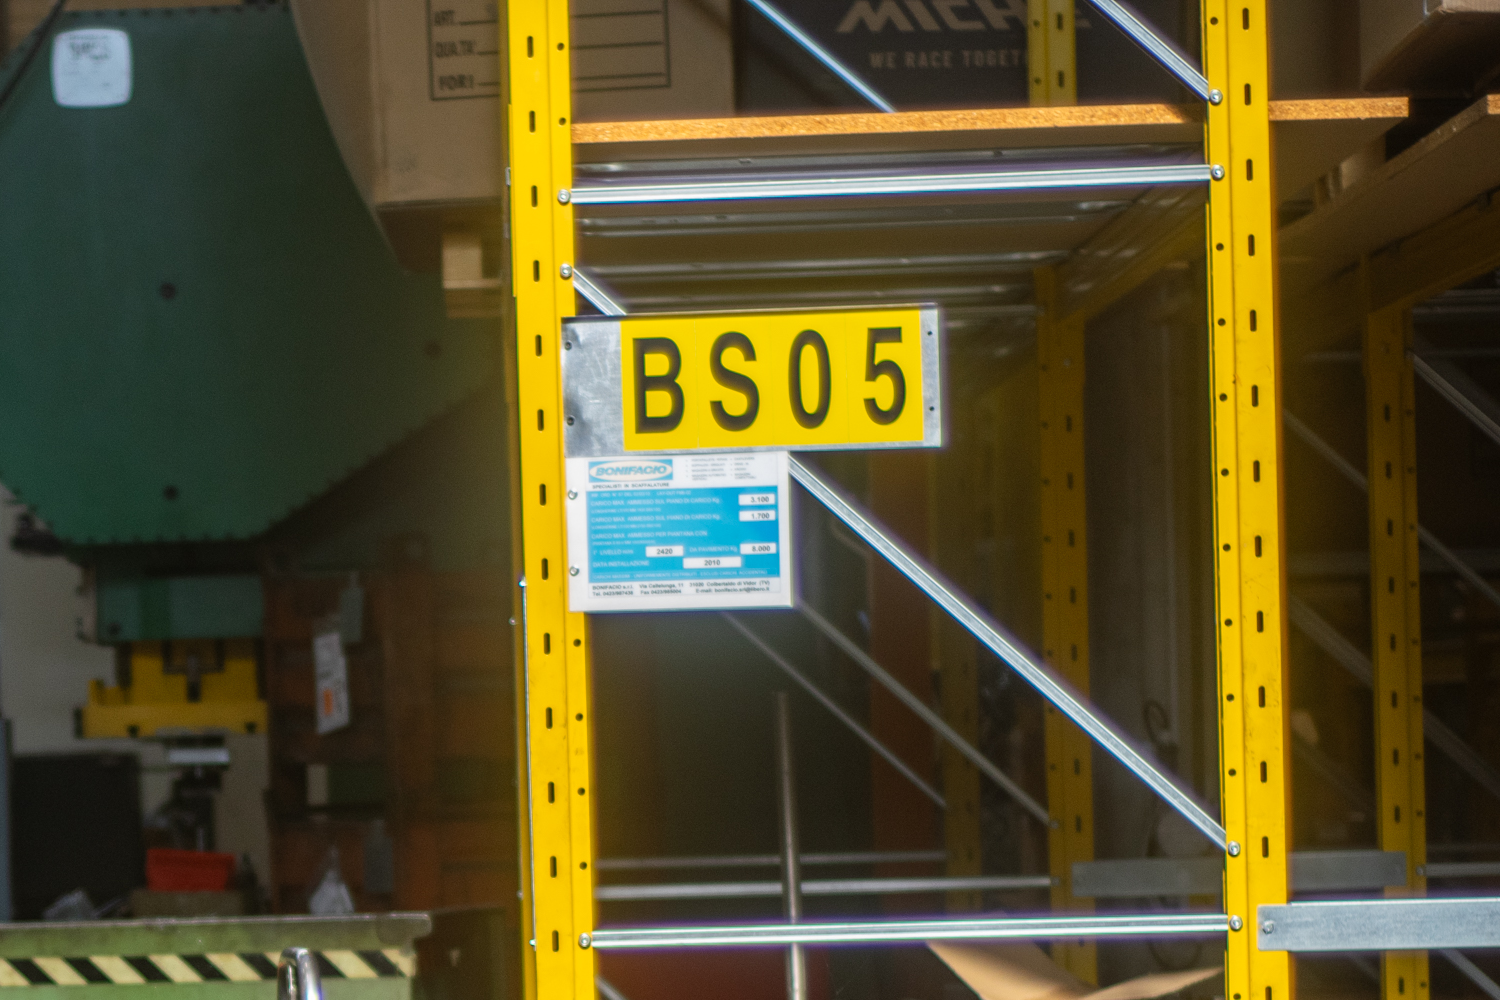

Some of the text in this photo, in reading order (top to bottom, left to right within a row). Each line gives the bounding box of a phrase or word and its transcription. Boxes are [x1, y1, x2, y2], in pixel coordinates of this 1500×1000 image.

[836, 0, 1093, 33] MICH
[869, 49, 1029, 69] WE RACE TOGET
[631, 325, 906, 434] BS05
[595, 465, 668, 476] BONIFACIO
